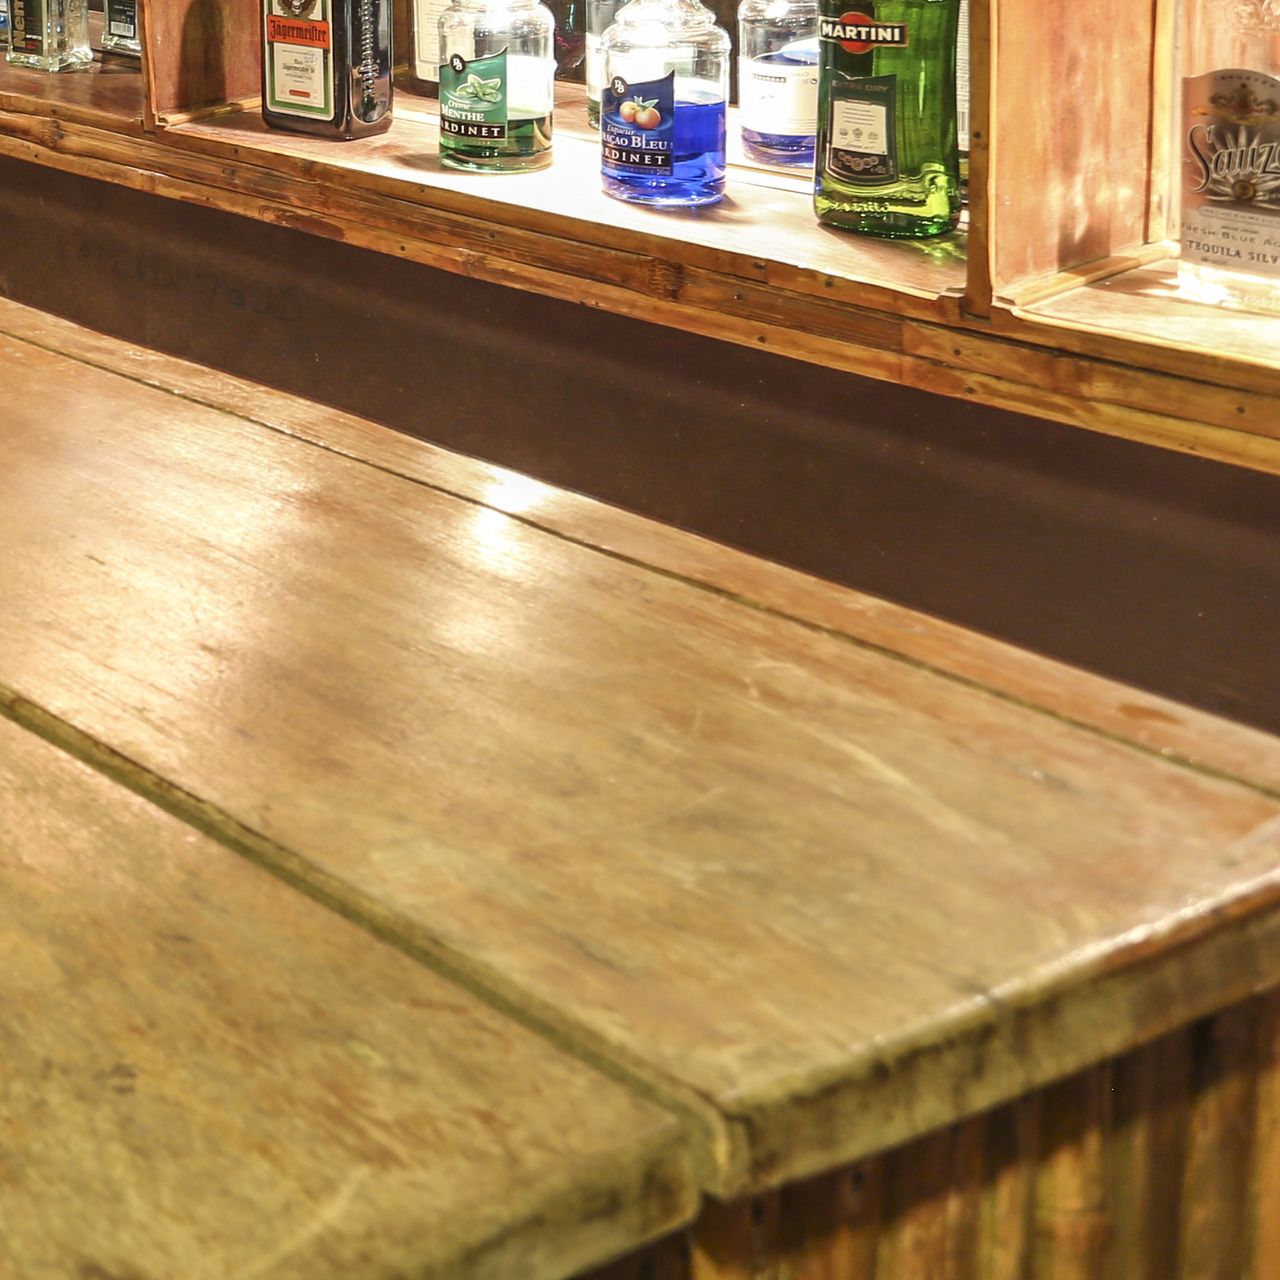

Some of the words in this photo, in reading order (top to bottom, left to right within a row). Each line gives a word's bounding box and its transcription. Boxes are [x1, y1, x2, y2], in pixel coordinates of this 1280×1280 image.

[821, 22, 901, 42] MARTINI
[441, 103, 485, 122] MENTHE
[603, 147, 665, 165] RDINET
[1187, 239, 1242, 258] TEQUILA
